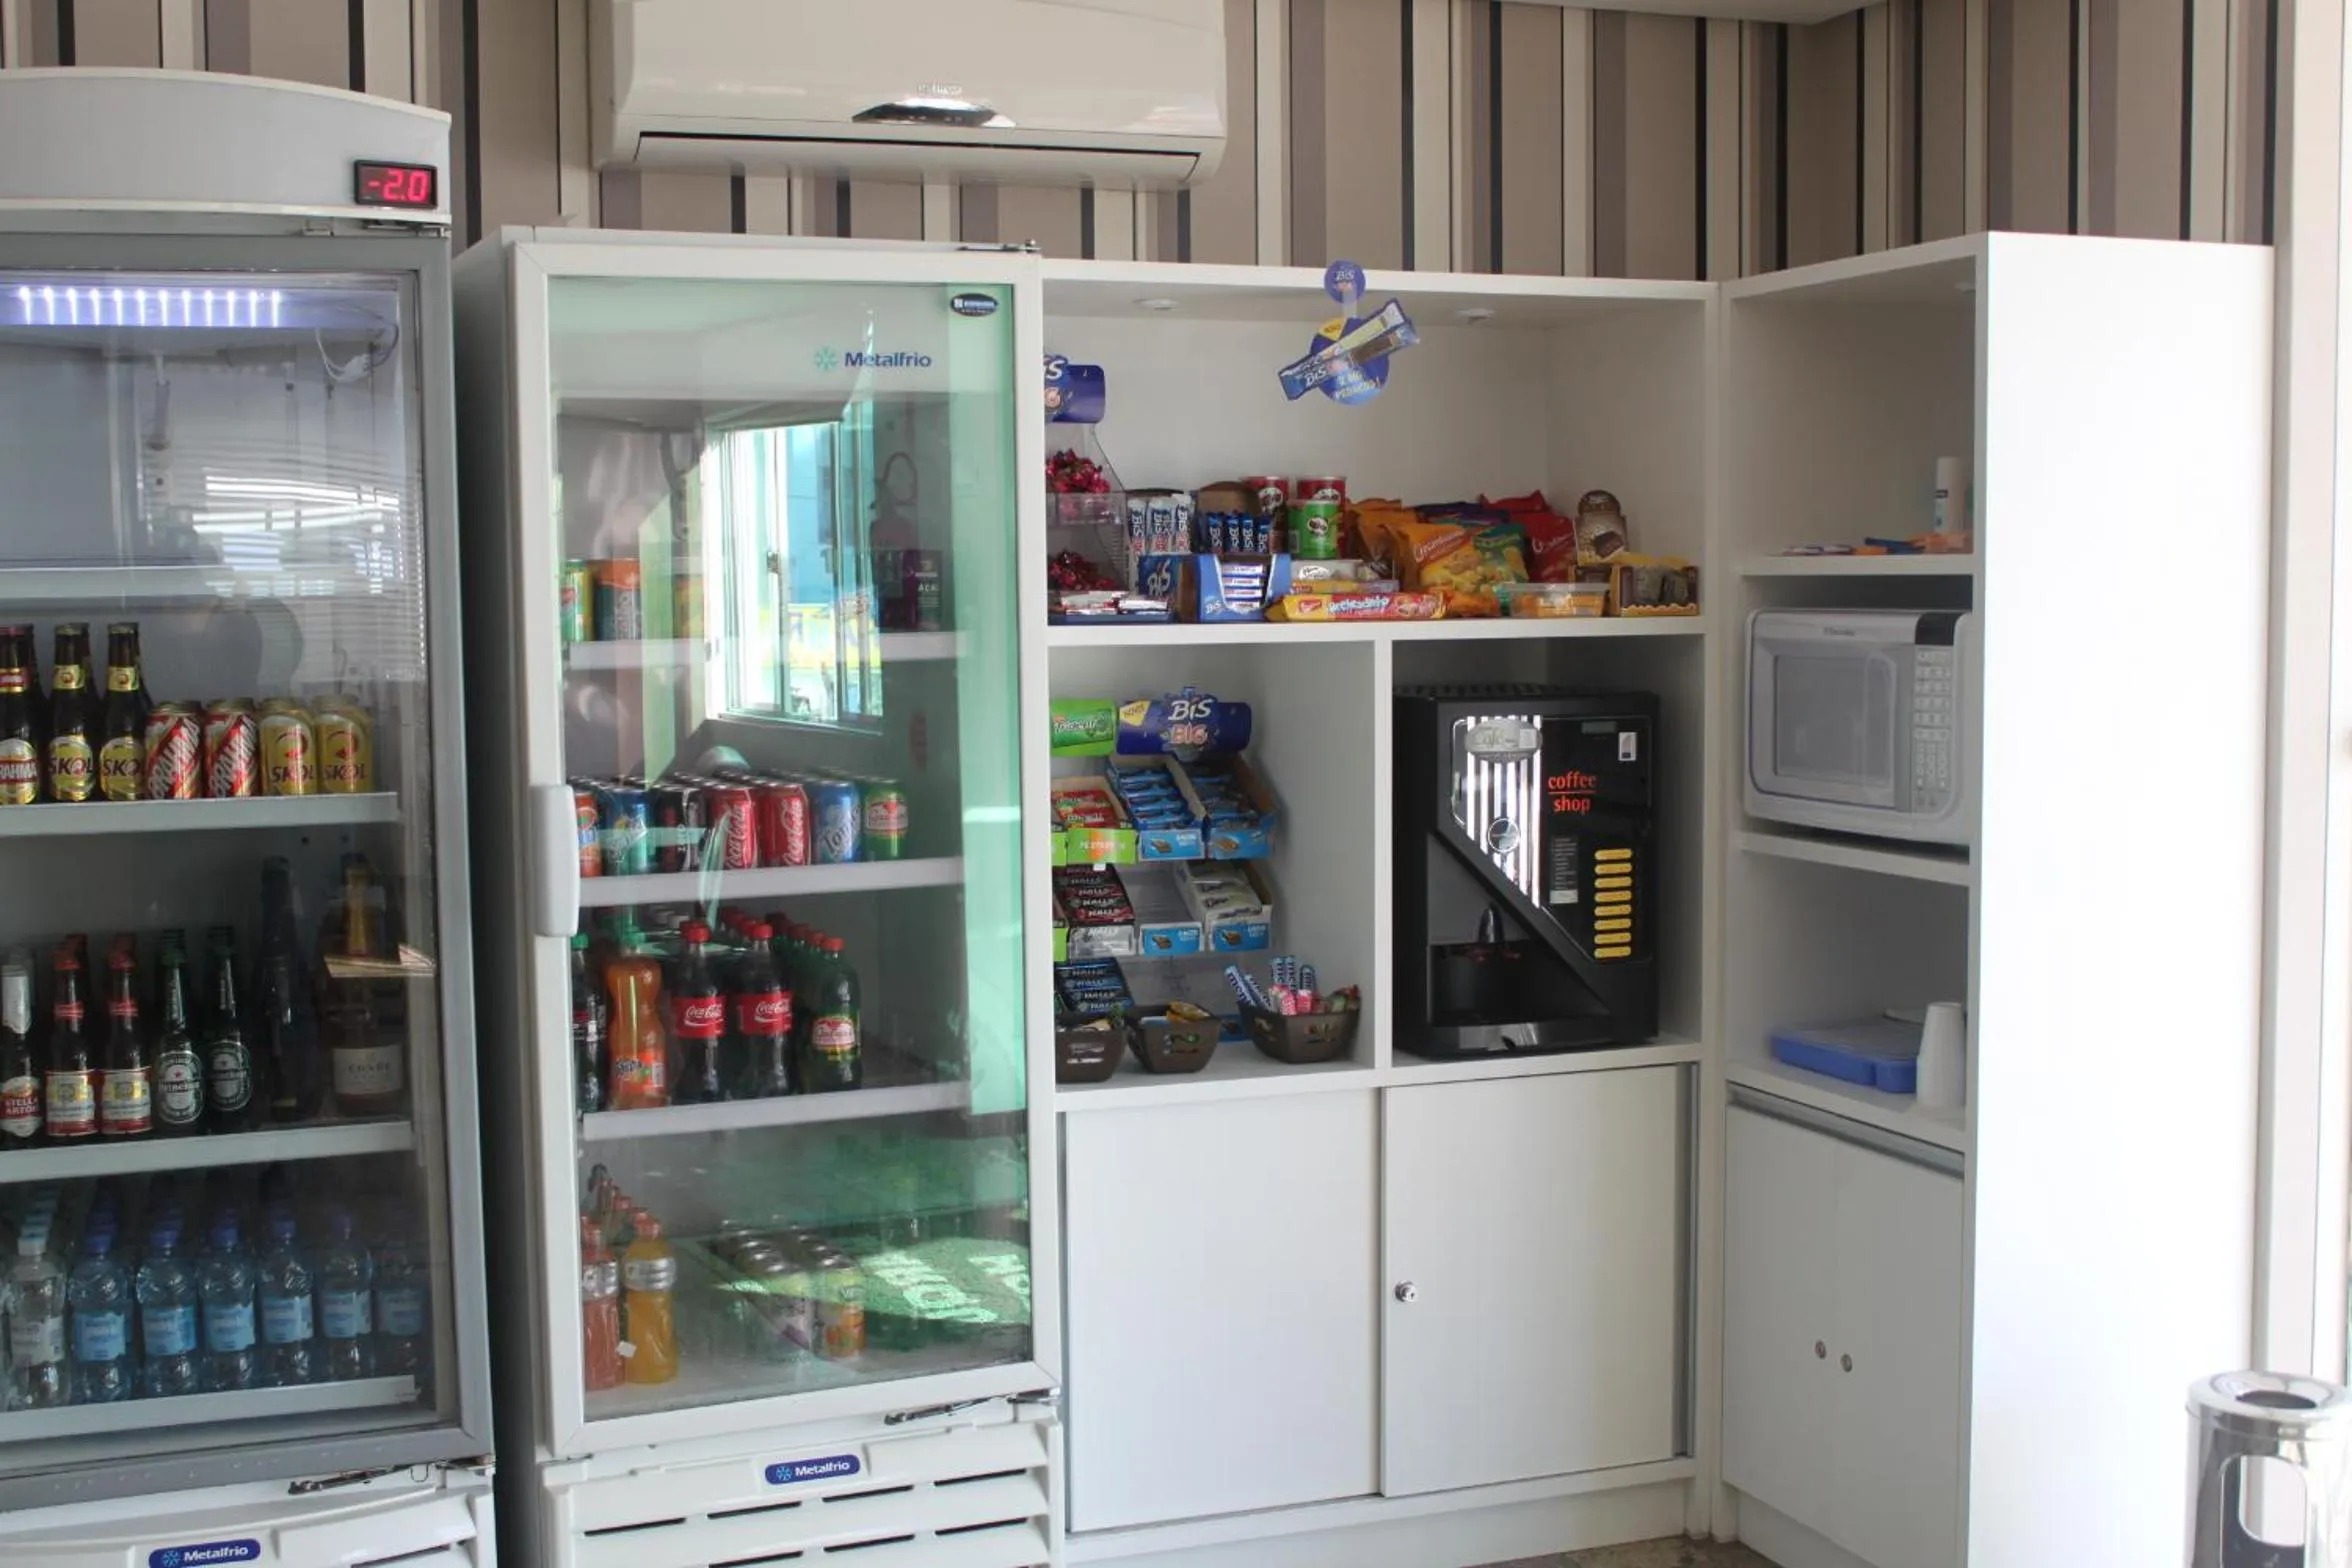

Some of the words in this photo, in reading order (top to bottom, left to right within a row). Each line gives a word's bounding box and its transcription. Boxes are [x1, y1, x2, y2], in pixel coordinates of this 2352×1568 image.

[367, 168, 428, 202] -2.0
[844, 351, 932, 367] Metalfrio
[1548, 770, 1597, 790] coffee
[1553, 795, 1591, 815] shop
[794, 1461, 851, 1477] Metalfrio
[184, 1545, 250, 1562] Metalfrio
